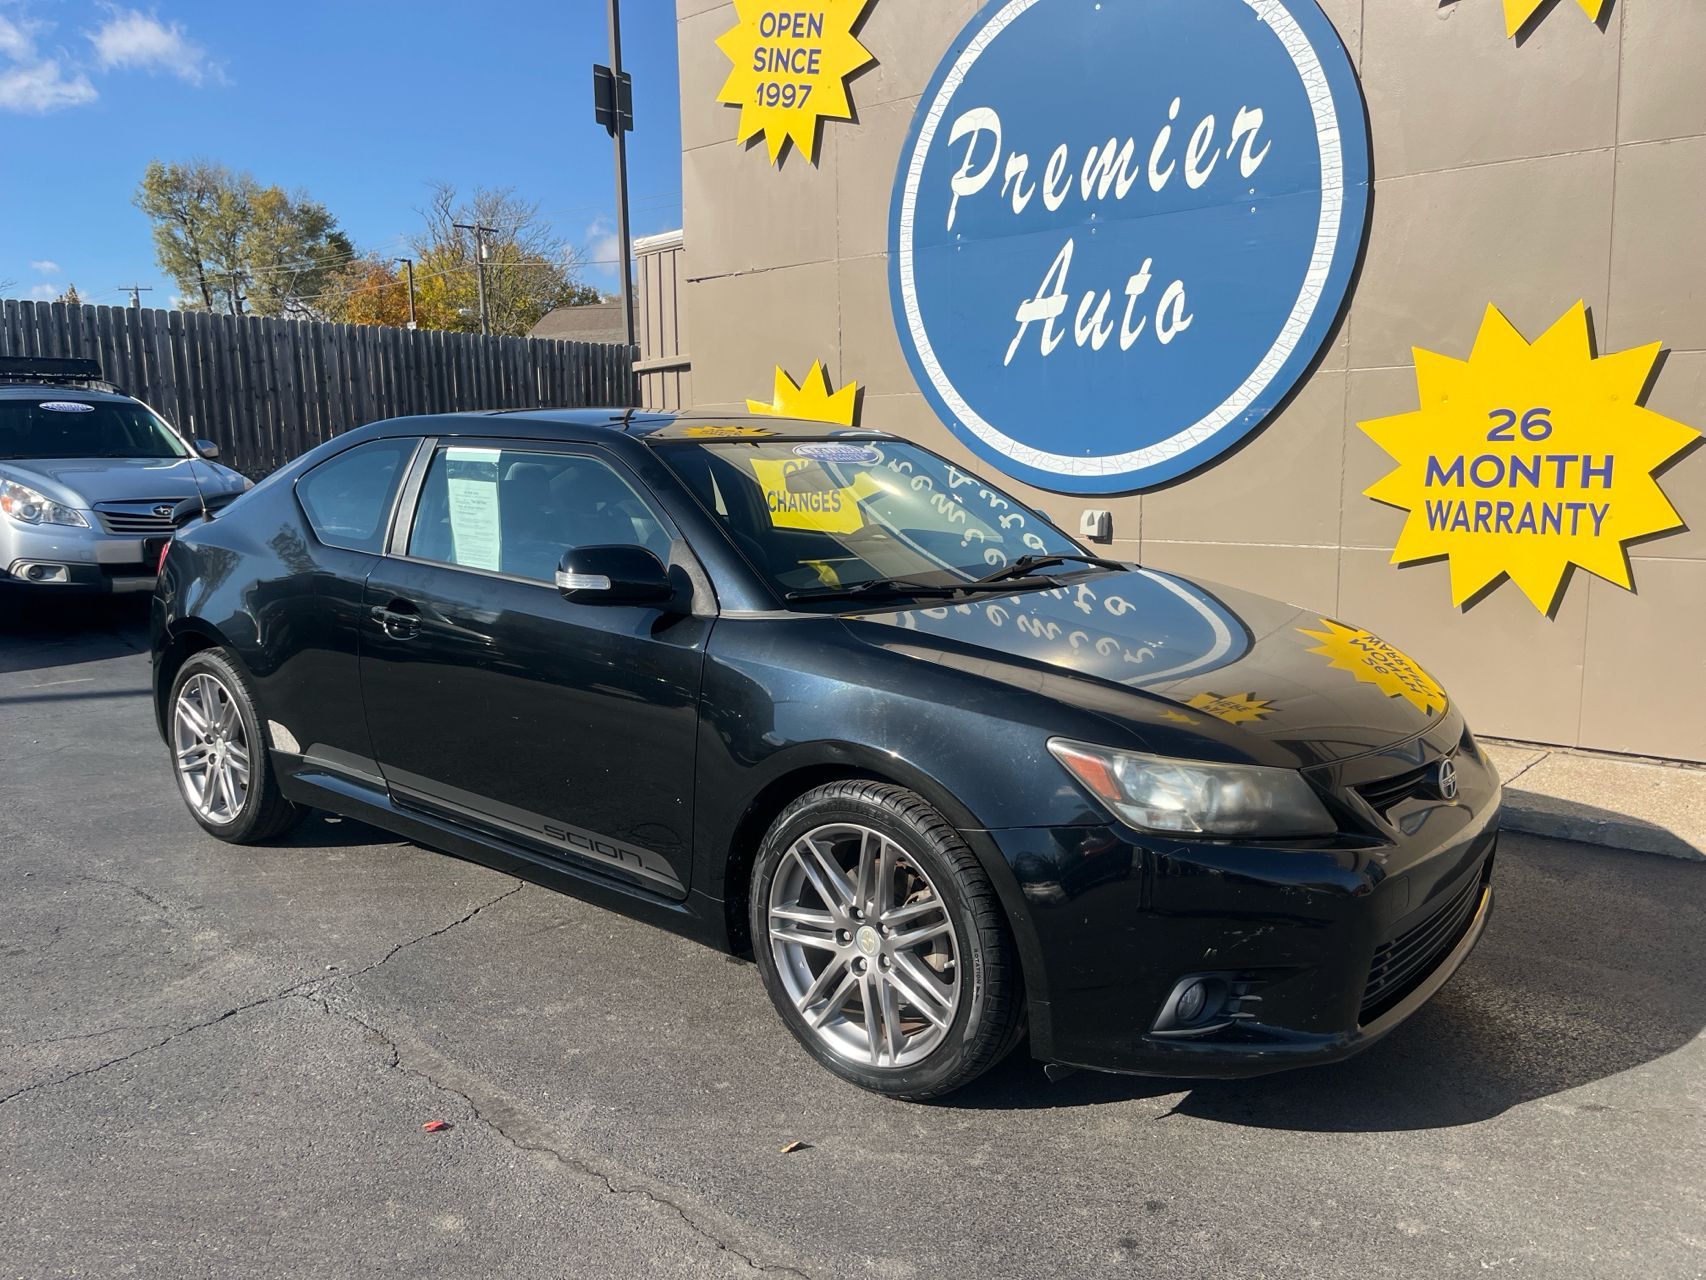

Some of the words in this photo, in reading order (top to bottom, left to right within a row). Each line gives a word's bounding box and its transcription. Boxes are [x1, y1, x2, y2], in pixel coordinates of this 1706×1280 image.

[759, 12, 824, 39] OPEN
[752, 47, 822, 75] SINCE
[755, 82, 812, 109] 1997
[946, 96, 1272, 232] Premier
[1003, 238, 1194, 366] Auto
[1486, 407, 1553, 442] 26
[1424, 454, 1614, 489] MONTH
[767, 490, 842, 513] CHANGES
[1425, 499, 1610, 537] WARRANTY
